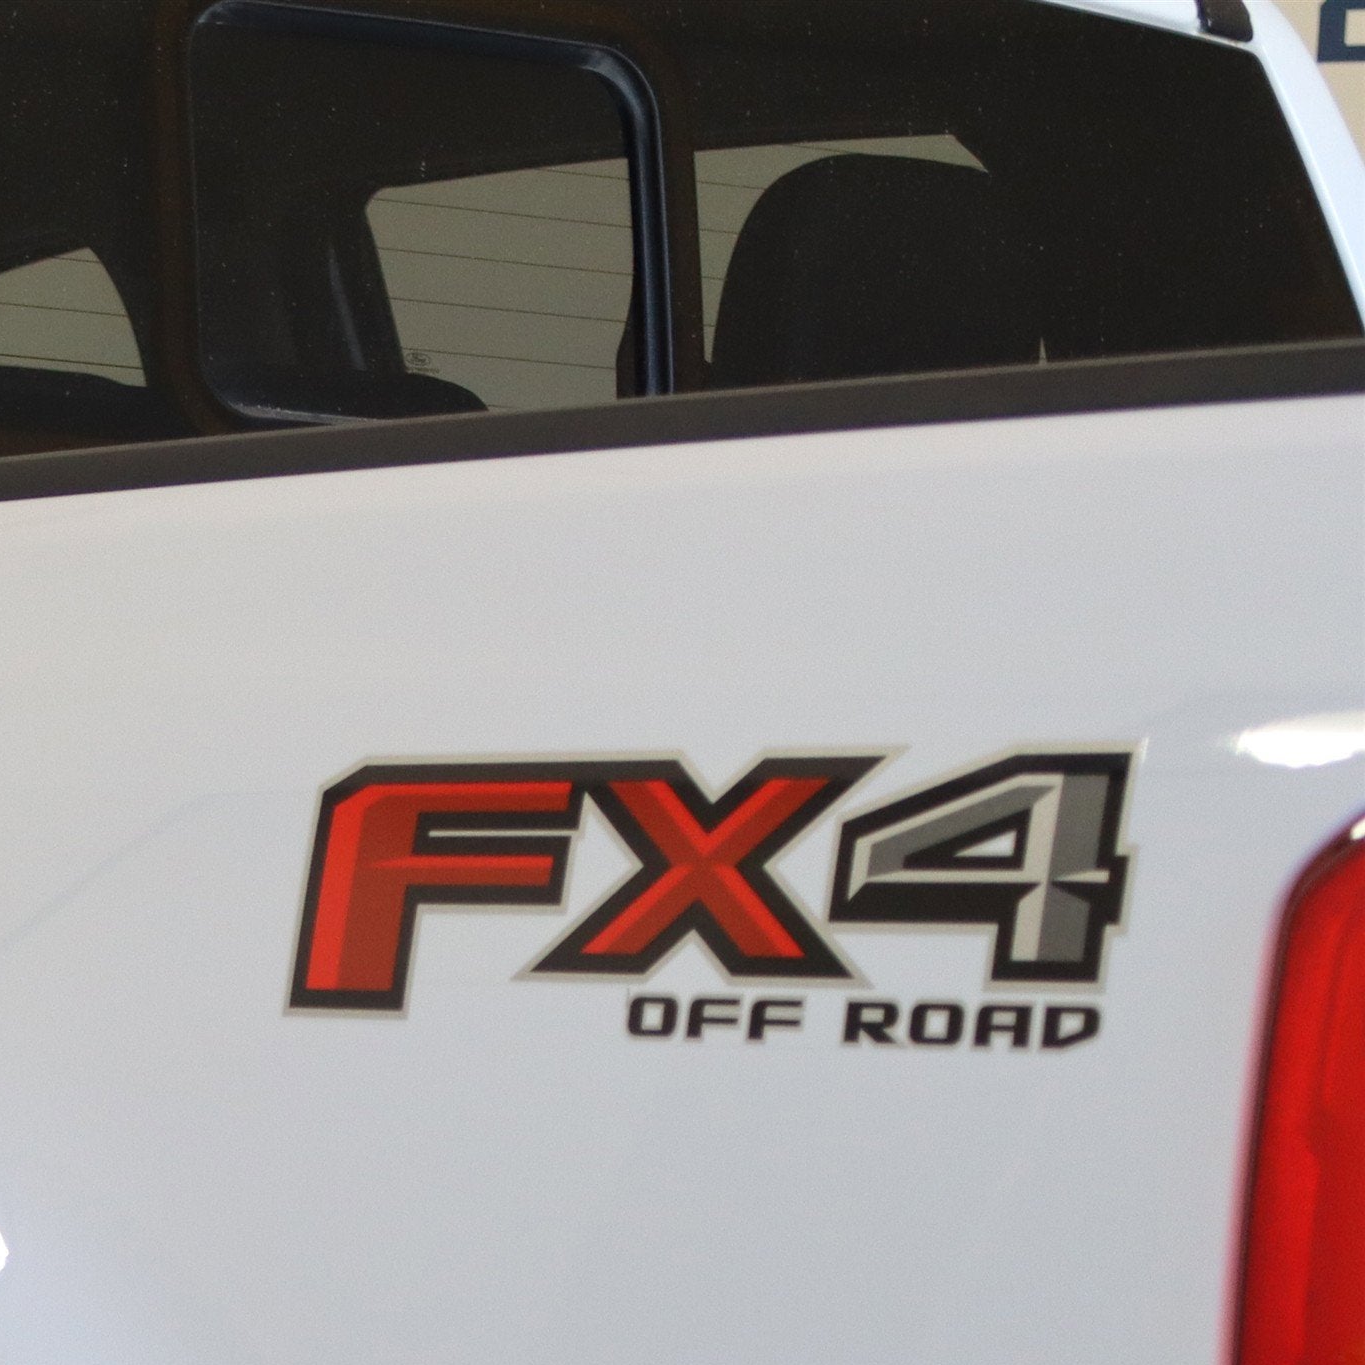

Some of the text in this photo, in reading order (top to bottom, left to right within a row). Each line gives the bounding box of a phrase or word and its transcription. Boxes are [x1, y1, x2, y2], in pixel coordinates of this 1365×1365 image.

[288, 750, 1135, 1012] FX4
[626, 995, 1101, 1049] OFF ROAD
